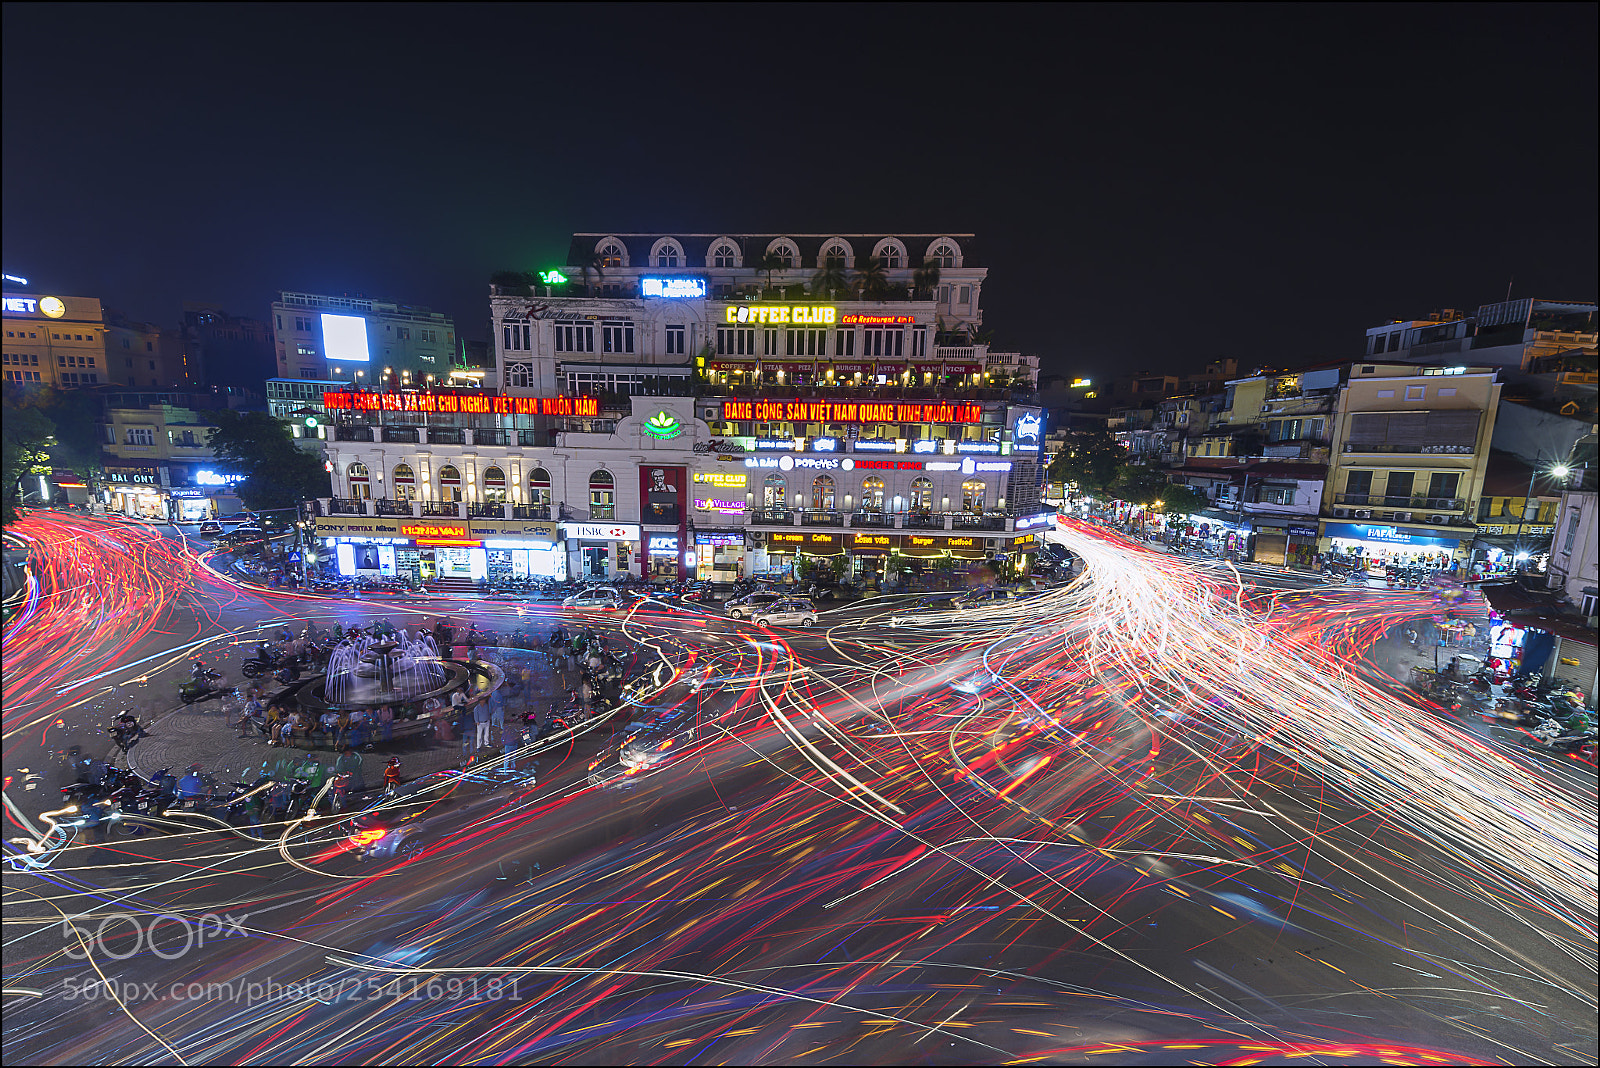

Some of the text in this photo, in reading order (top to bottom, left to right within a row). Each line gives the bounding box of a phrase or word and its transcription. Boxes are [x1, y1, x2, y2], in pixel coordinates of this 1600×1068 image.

[793, 307, 835, 323] CLUB
[858, 315, 895, 323] Restaurant
[438, 390, 458, 412] CHỦ
[460, 392, 490, 413] NGHĨA
[492, 392, 513, 417] VIỆT
[515, 397, 538, 414] NAM
[542, 394, 571, 415] MUÔN
[574, 394, 598, 416] NĂM
[724, 397, 981, 424] ĐẢNG CỘNG SẢN VIỆT NAM QUANG VINH MUÔN NĂM
[708, 439, 745, 453] Kitchen
[855, 461, 895, 470] BURGER
[897, 461, 922, 470] KING
[725, 474, 747, 483] CLUB
[577, 527, 606, 536] HSBC
[648, 537, 678, 548] KFC
[812, 534, 832, 542] Coffee
[912, 537, 934, 545] Burger
